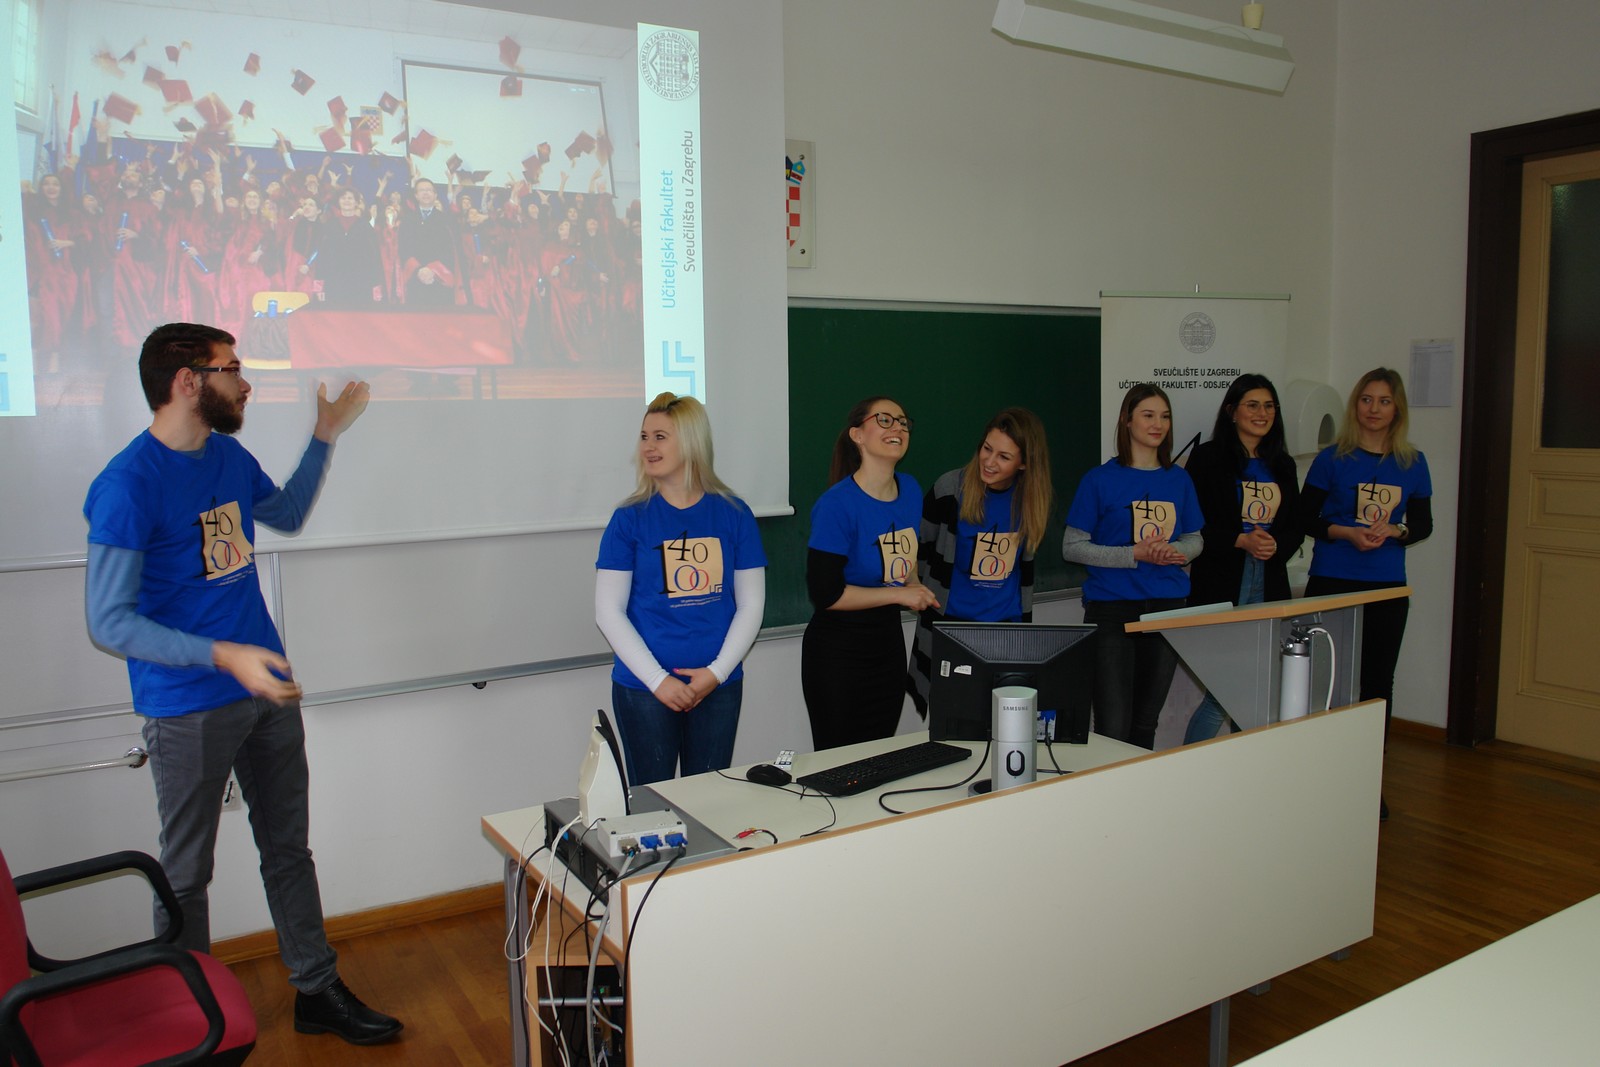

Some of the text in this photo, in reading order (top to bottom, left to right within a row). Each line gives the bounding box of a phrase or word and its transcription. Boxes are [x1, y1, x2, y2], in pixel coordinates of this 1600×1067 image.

[681, 130, 697, 272] Sveučilišta u Zagrebu
[660, 170, 678, 309] Učiteljski fakultet
[1153, 367, 1241, 377] SVEUČILIŠTE U ZAGREBU
[1162, 380, 1198, 389] FAKULTET
[1203, 380, 1231, 389] ODSJEK
